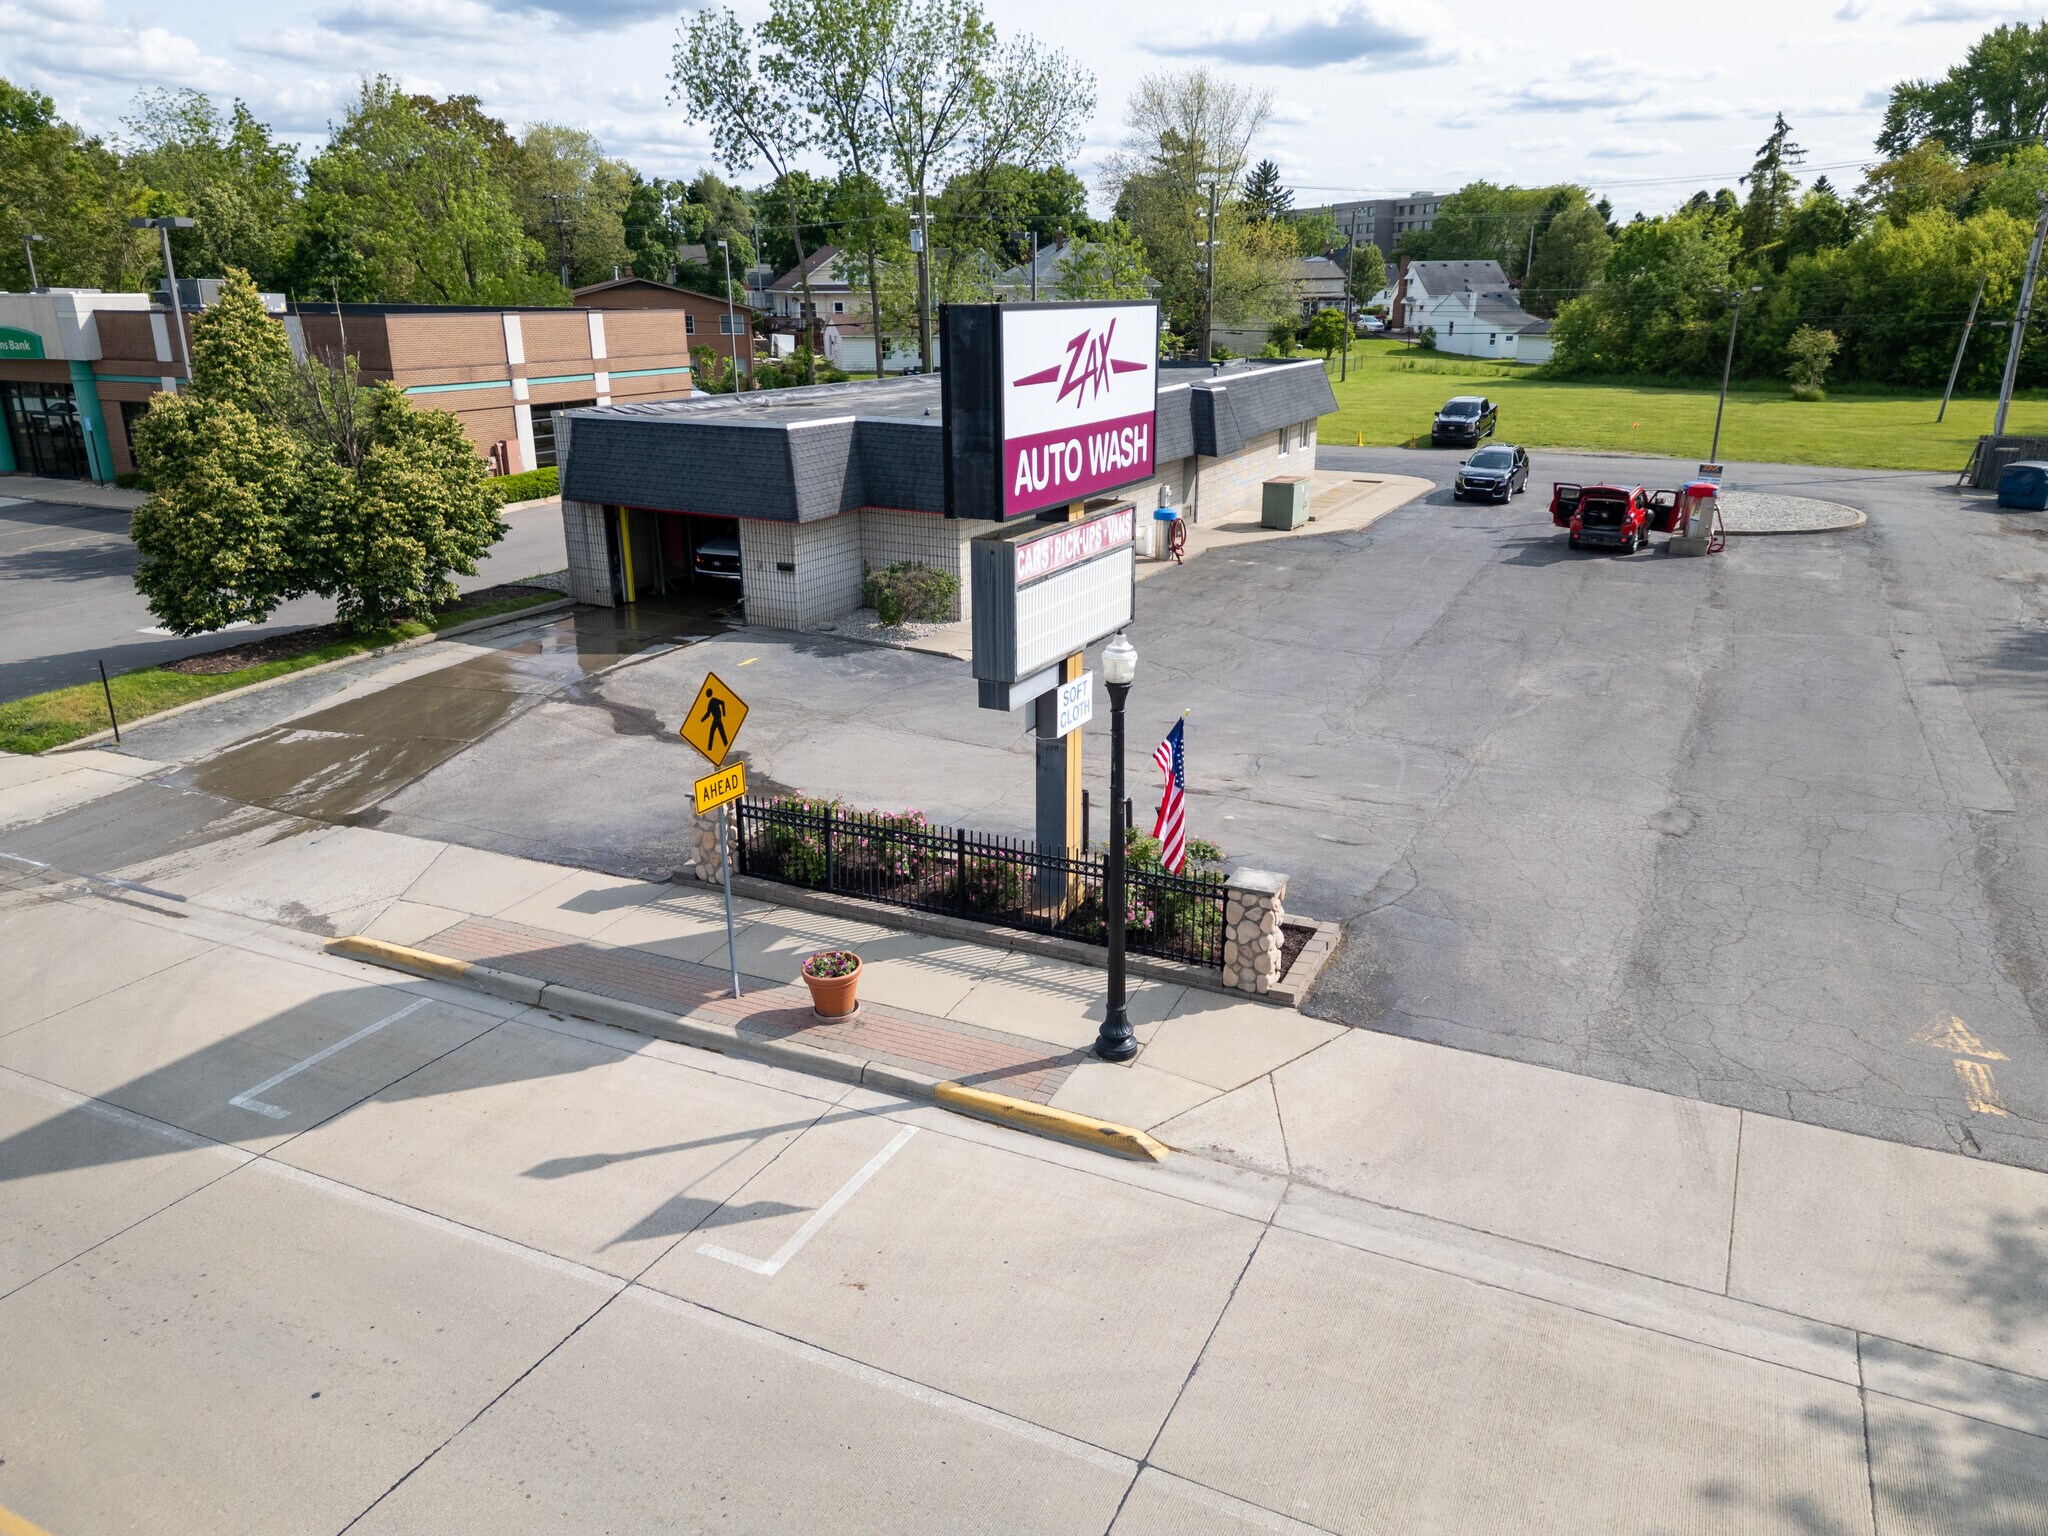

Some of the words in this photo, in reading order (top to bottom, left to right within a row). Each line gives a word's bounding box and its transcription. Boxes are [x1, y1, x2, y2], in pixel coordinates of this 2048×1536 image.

[9, 340, 31, 350] Bank
[1056, 317, 1117, 409] ZAX
[1014, 438, 1083, 496] AUTO
[1088, 423, 1148, 476] WASH
[1016, 541, 1050, 577] CARS
[1054, 522, 1103, 561] PICK-UPS
[1107, 513, 1132, 544] VANS
[1063, 680, 1088, 707] SOFT
[1060, 698, 1090, 728] CLOTH
[703, 774, 739, 803] AHEAD
